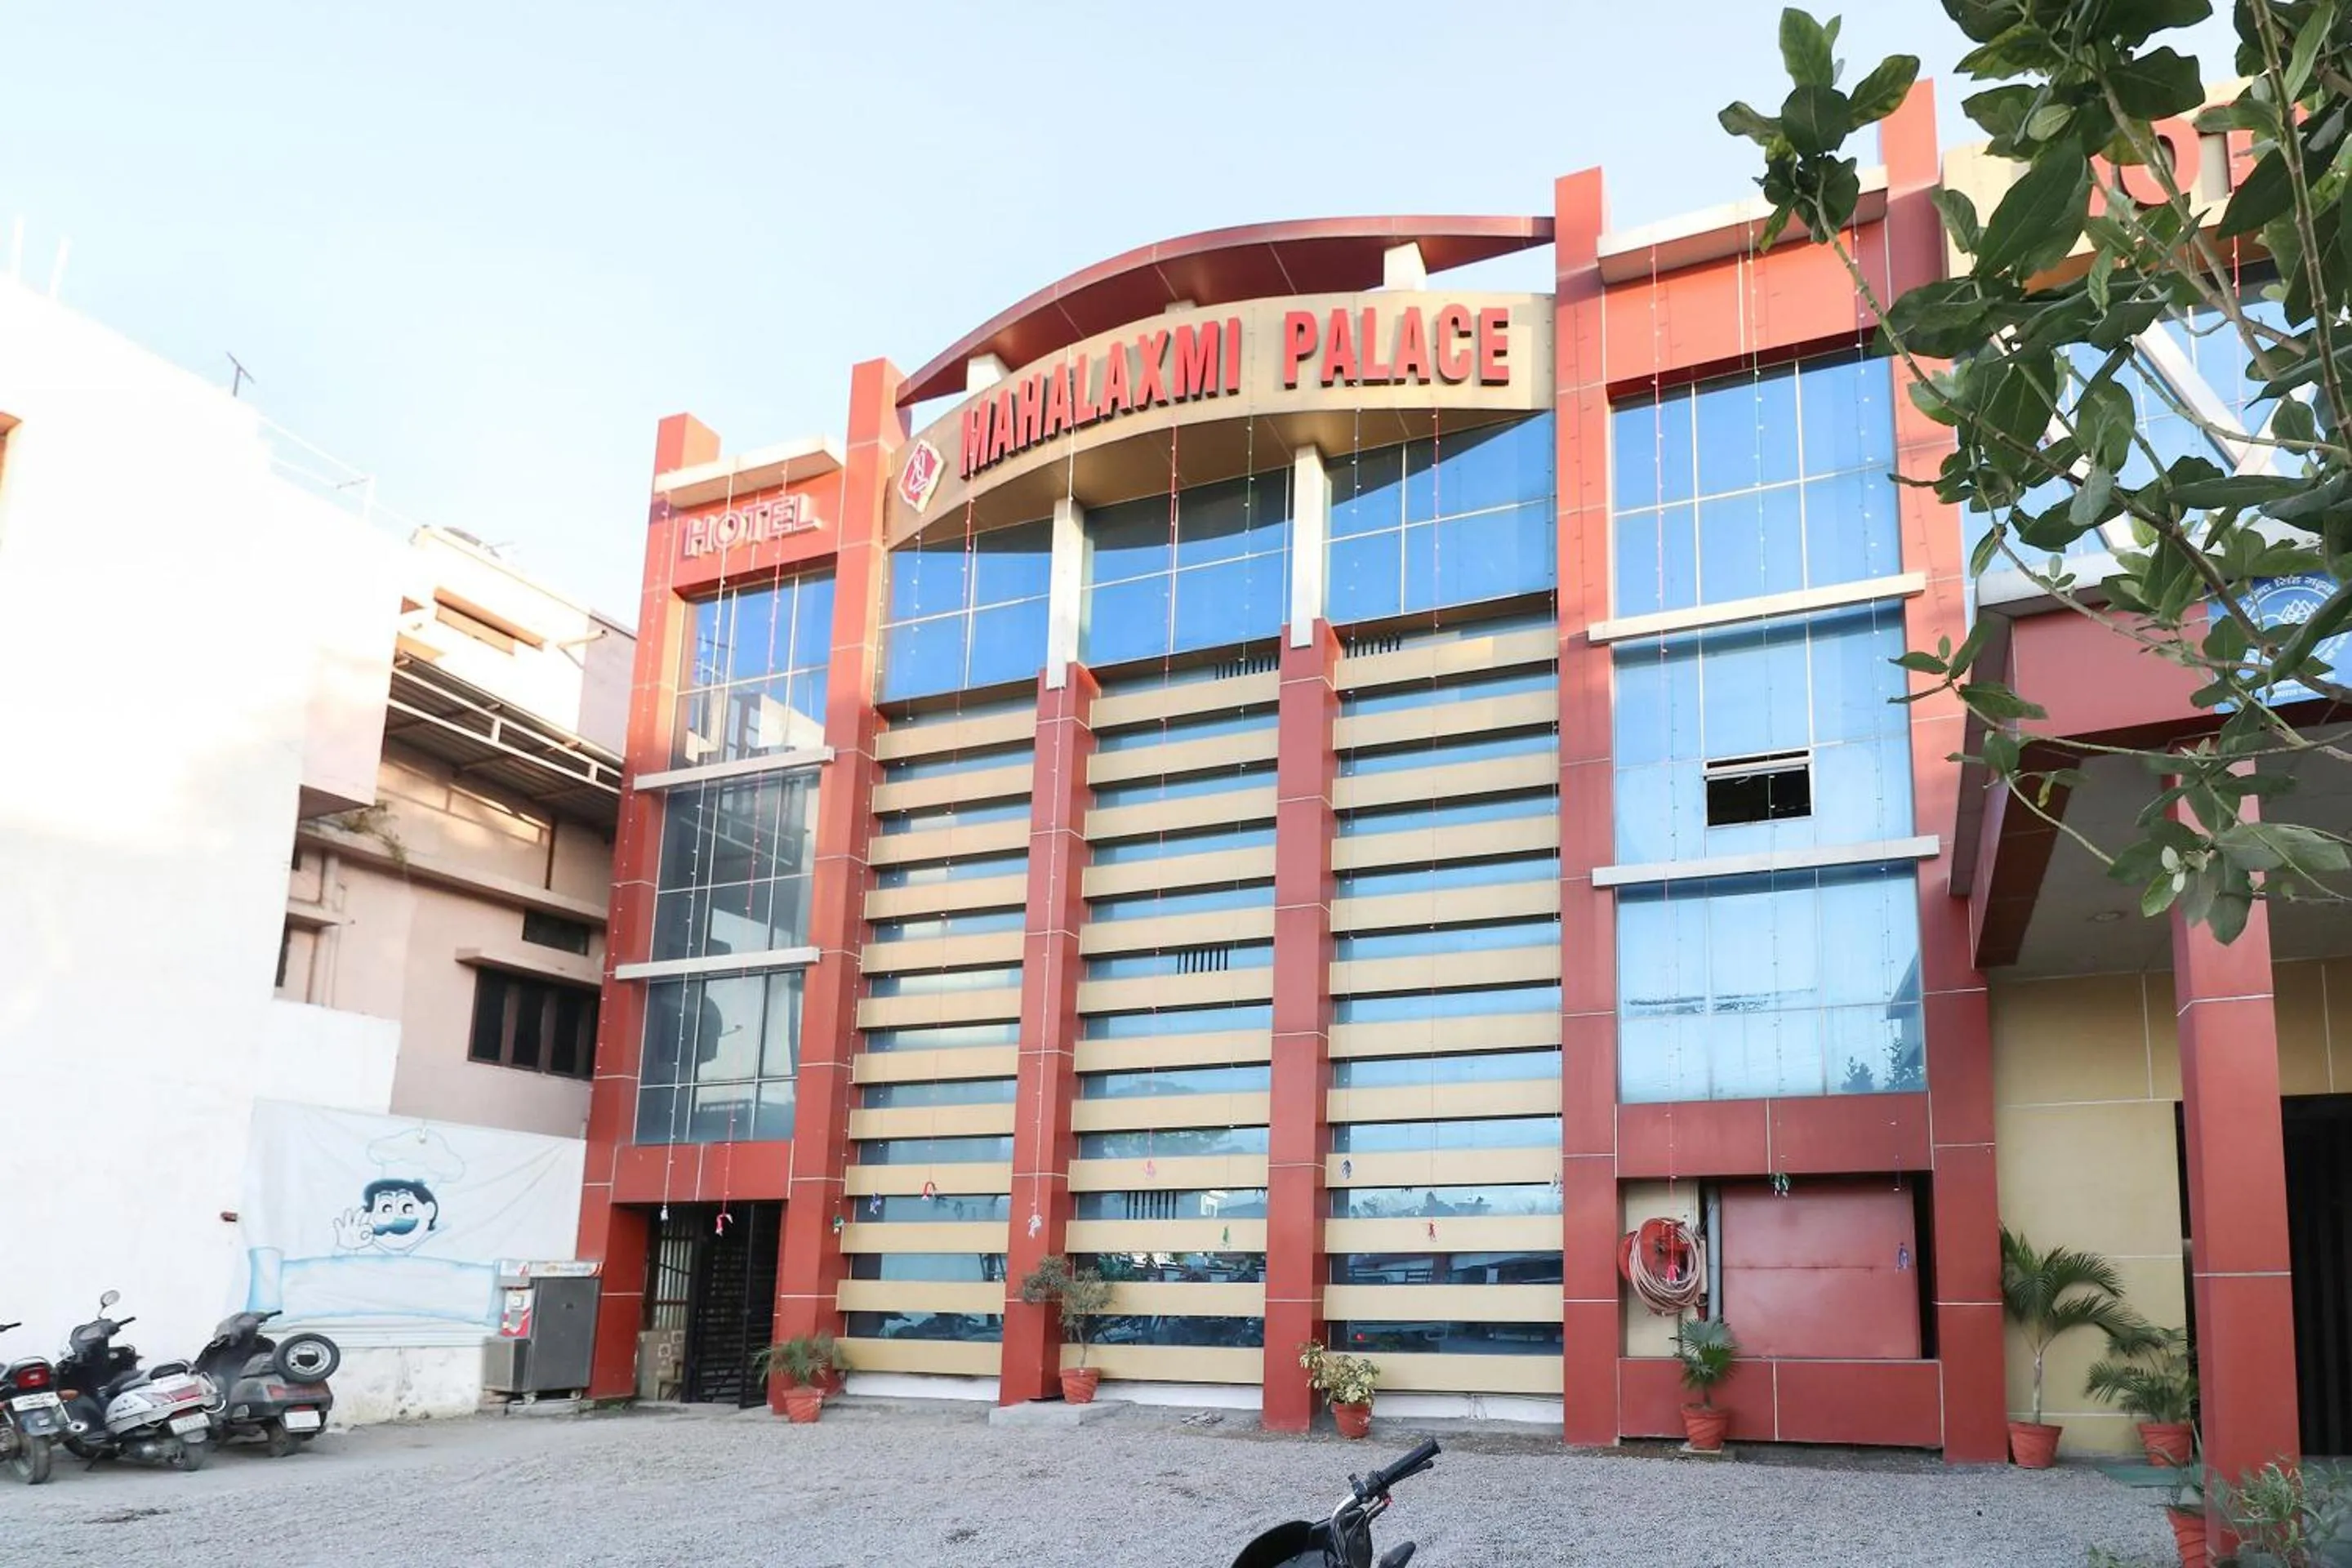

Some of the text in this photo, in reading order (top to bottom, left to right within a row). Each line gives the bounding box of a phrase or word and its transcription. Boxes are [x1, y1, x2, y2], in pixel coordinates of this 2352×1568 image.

[960, 303, 1509, 479] MAHALAXMI PALACE
[684, 494, 821, 556] HOTEL
